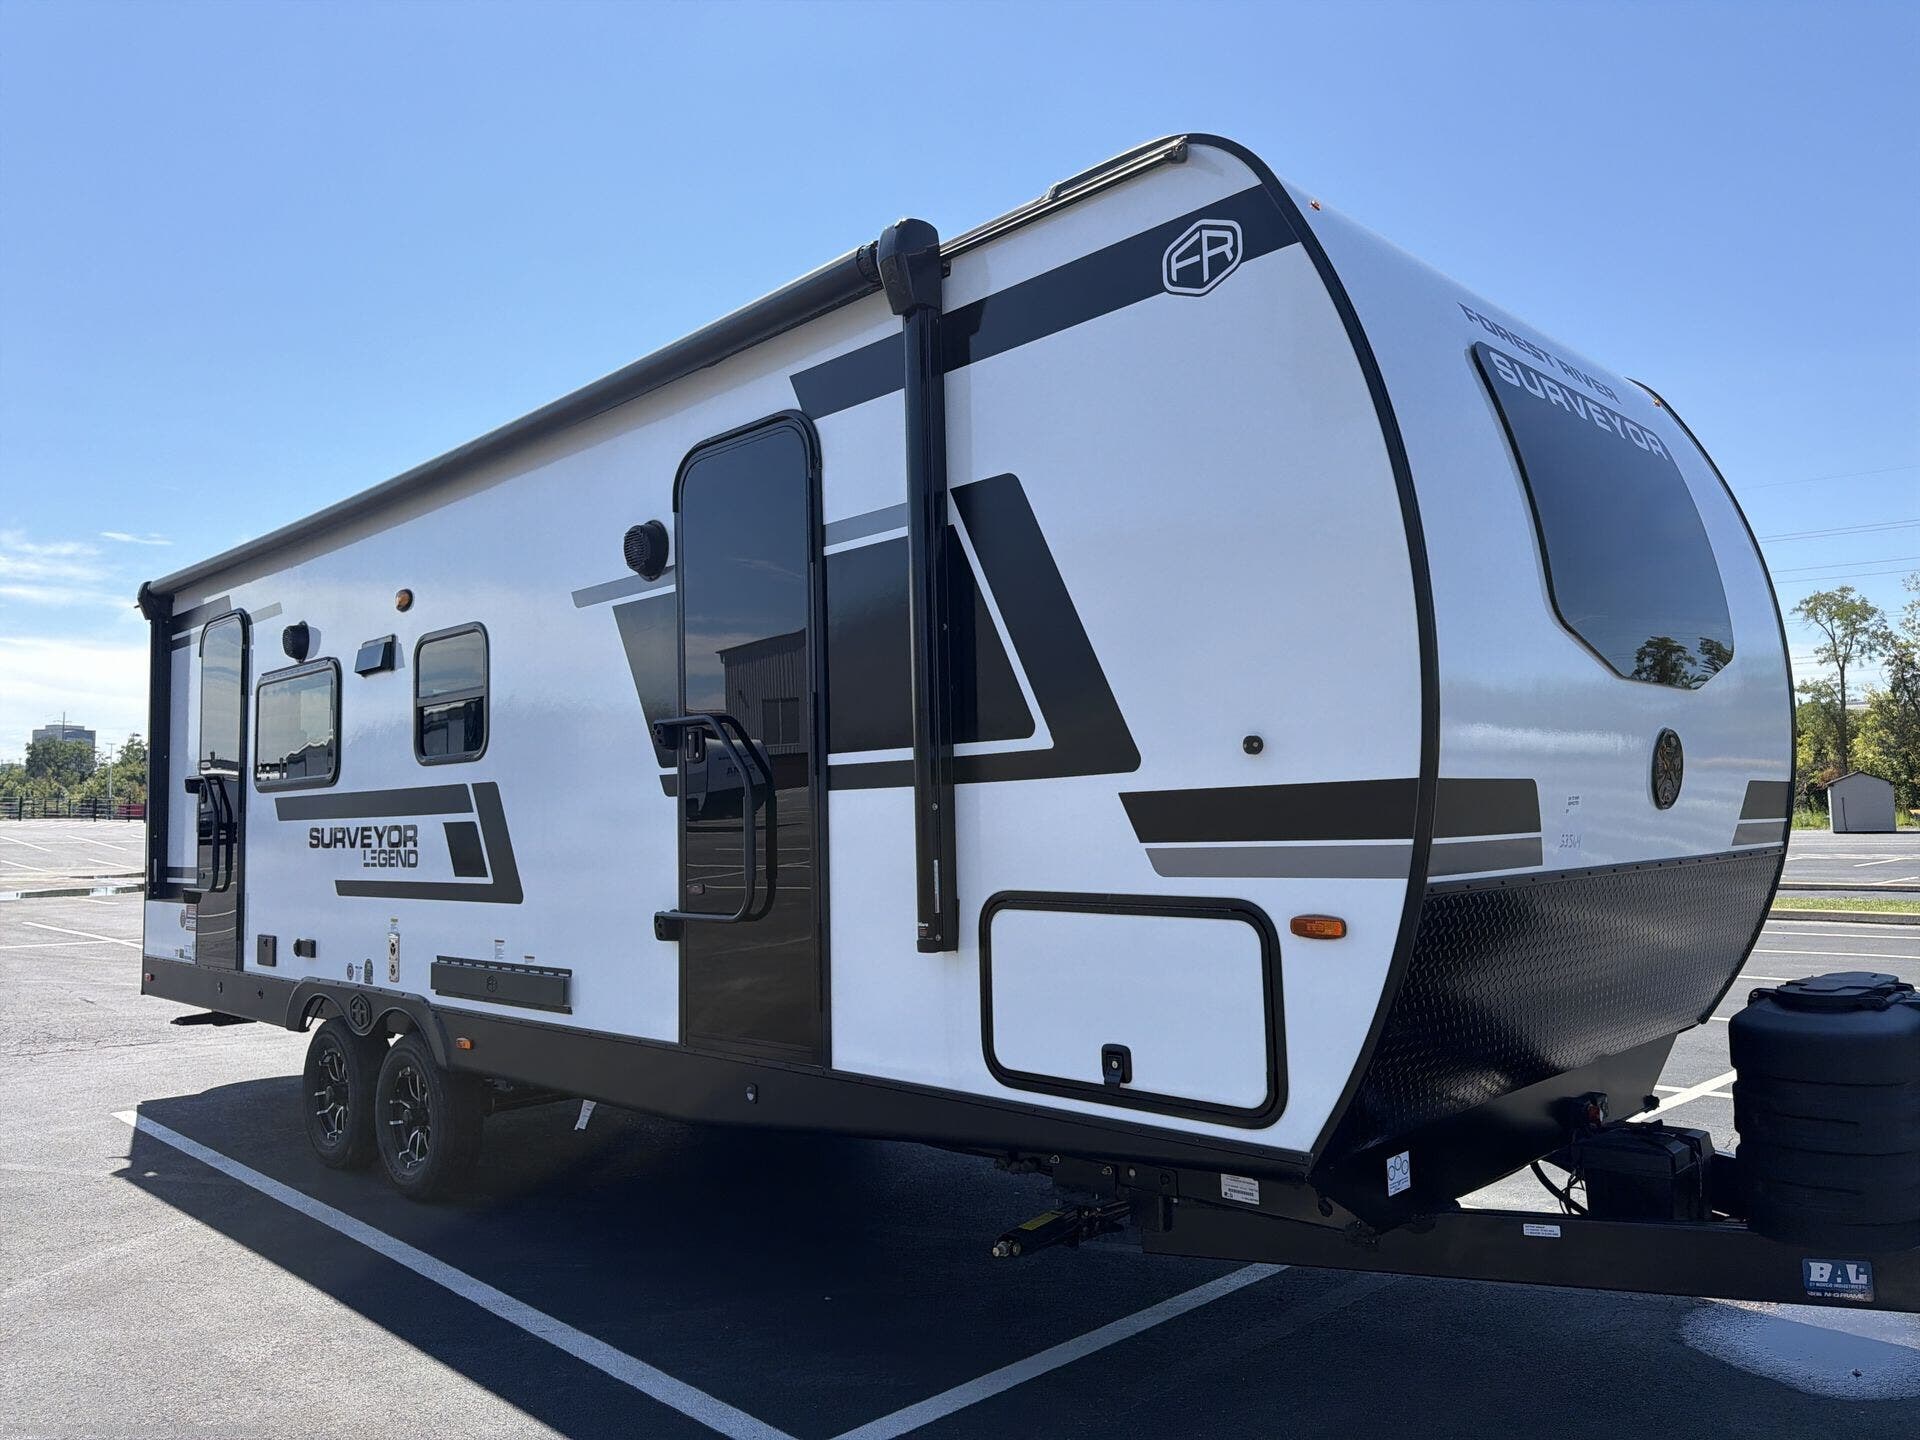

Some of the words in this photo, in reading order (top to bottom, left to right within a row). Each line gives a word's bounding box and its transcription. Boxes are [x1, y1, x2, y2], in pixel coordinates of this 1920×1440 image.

[1457, 301, 1555, 368] FOREST
[1554, 357, 1622, 405] RIVER
[1489, 351, 1669, 461] SURVEYOR
[308, 824, 418, 849] SURVEYOR
[363, 849, 419, 869] LEGEND
[1808, 1261, 1868, 1285] BAL
